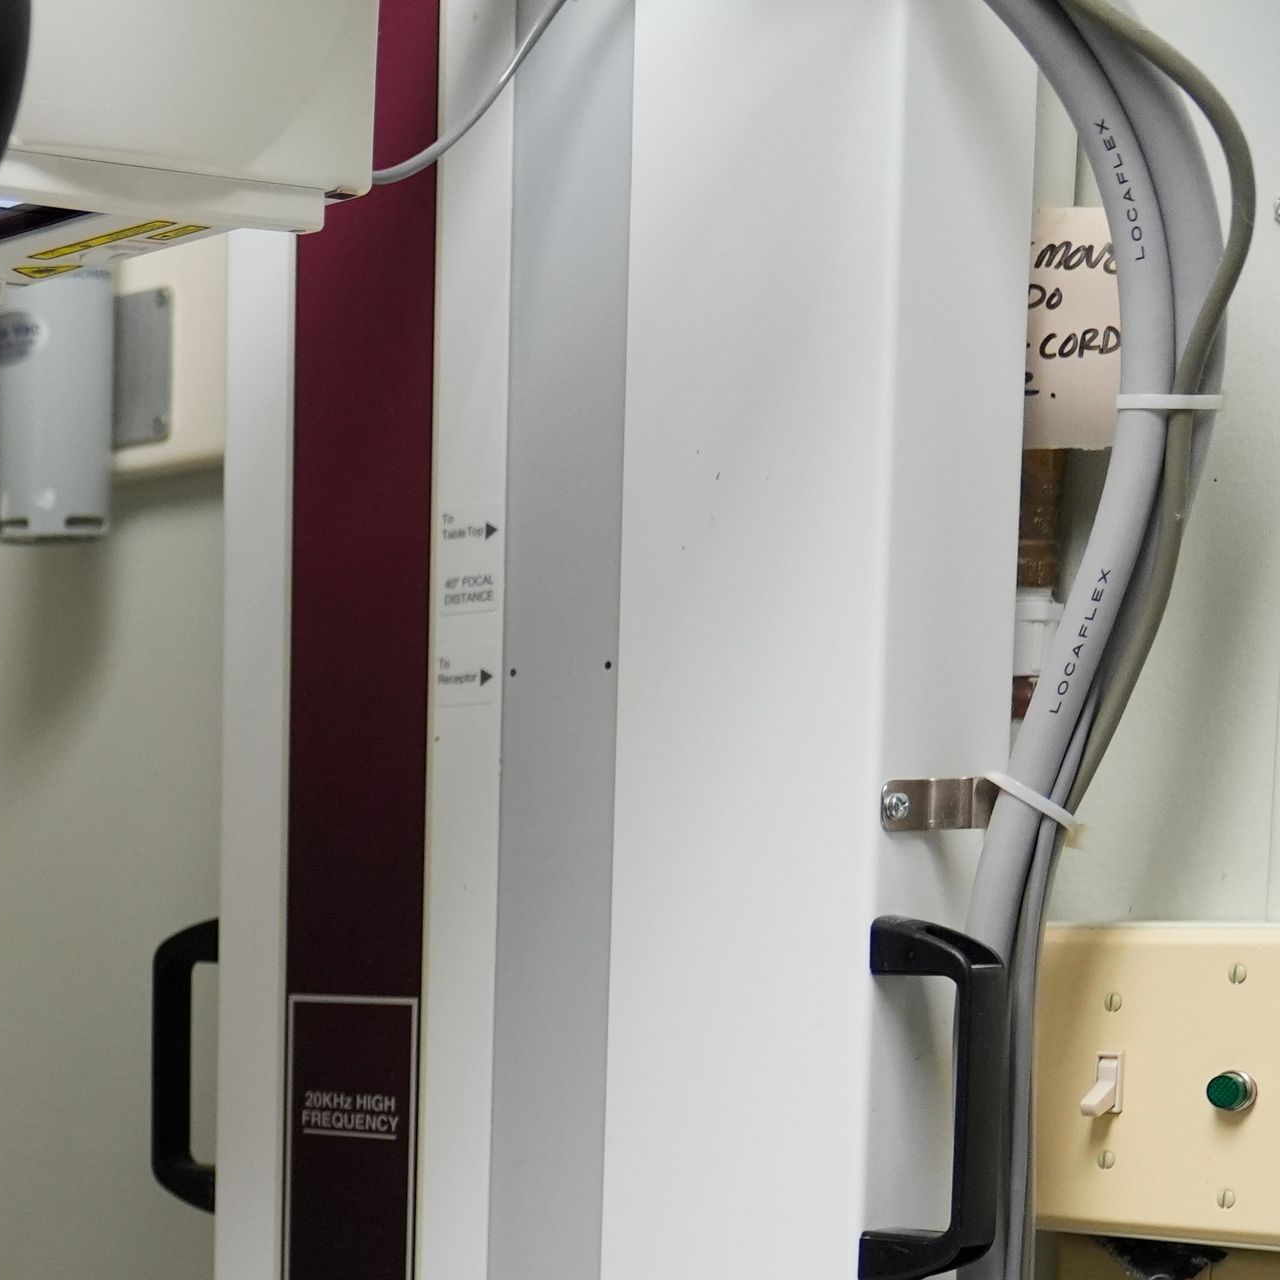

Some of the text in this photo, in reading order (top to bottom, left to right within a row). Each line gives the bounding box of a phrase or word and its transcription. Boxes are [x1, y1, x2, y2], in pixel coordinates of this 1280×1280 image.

[1094, 118, 1145, 261] LOCAFLEX
[1039, 325, 1121, 360] CORD
[442, 513, 454, 525] To
[467, 526, 484, 538] Top
[461, 574, 494, 588] FOCAL
[444, 590, 494, 606] DISTANCE
[1049, 568, 1112, 714] LOCAFLEX
[304, 1090, 396, 1113] 20KHz HIGH
[301, 1108, 399, 1132] FREQUENCY
